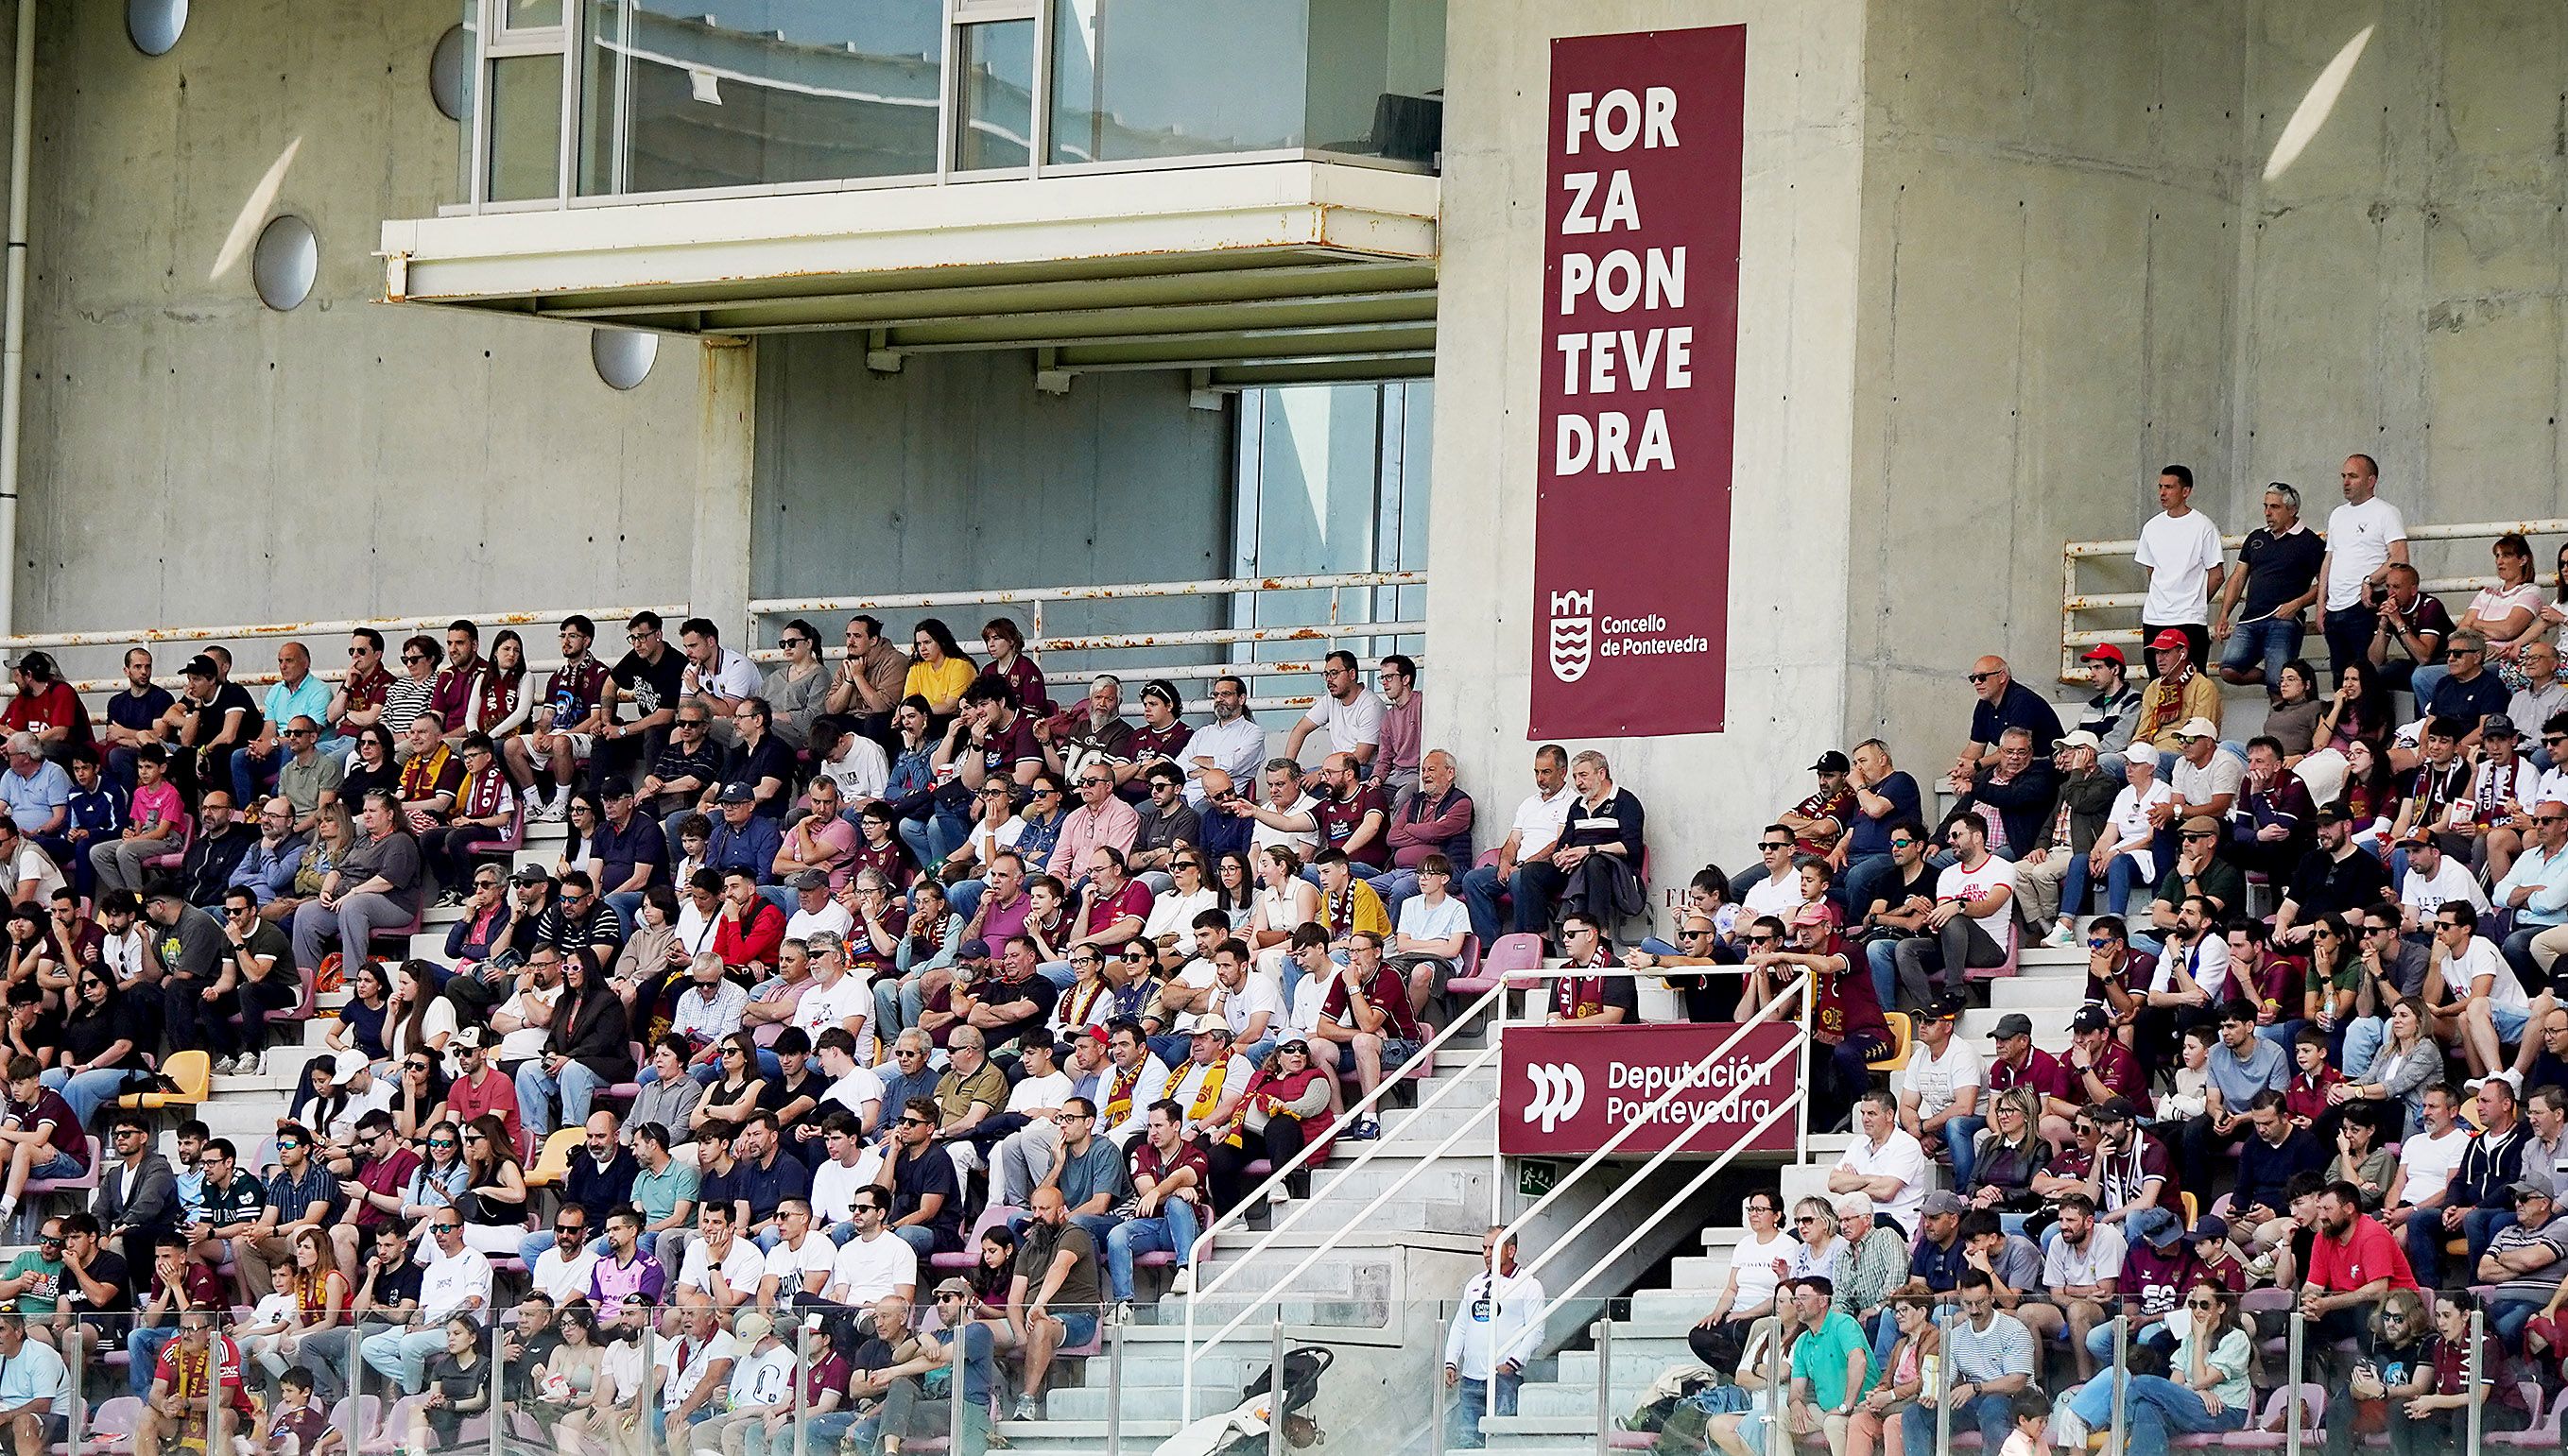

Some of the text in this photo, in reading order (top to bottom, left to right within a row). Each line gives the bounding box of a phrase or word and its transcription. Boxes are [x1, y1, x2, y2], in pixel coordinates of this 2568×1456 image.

[1566, 86, 1680, 155] FOR
[1561, 169, 1641, 234] ZA
[1560, 246, 1686, 316] PON
[1557, 326, 1693, 395] TEVE
[1555, 408, 1676, 476] DRA
[1600, 614, 1666, 634] Concello
[1600, 635, 1708, 657] de Pontevedra
[1608, 1054, 1771, 1098] Deputación
